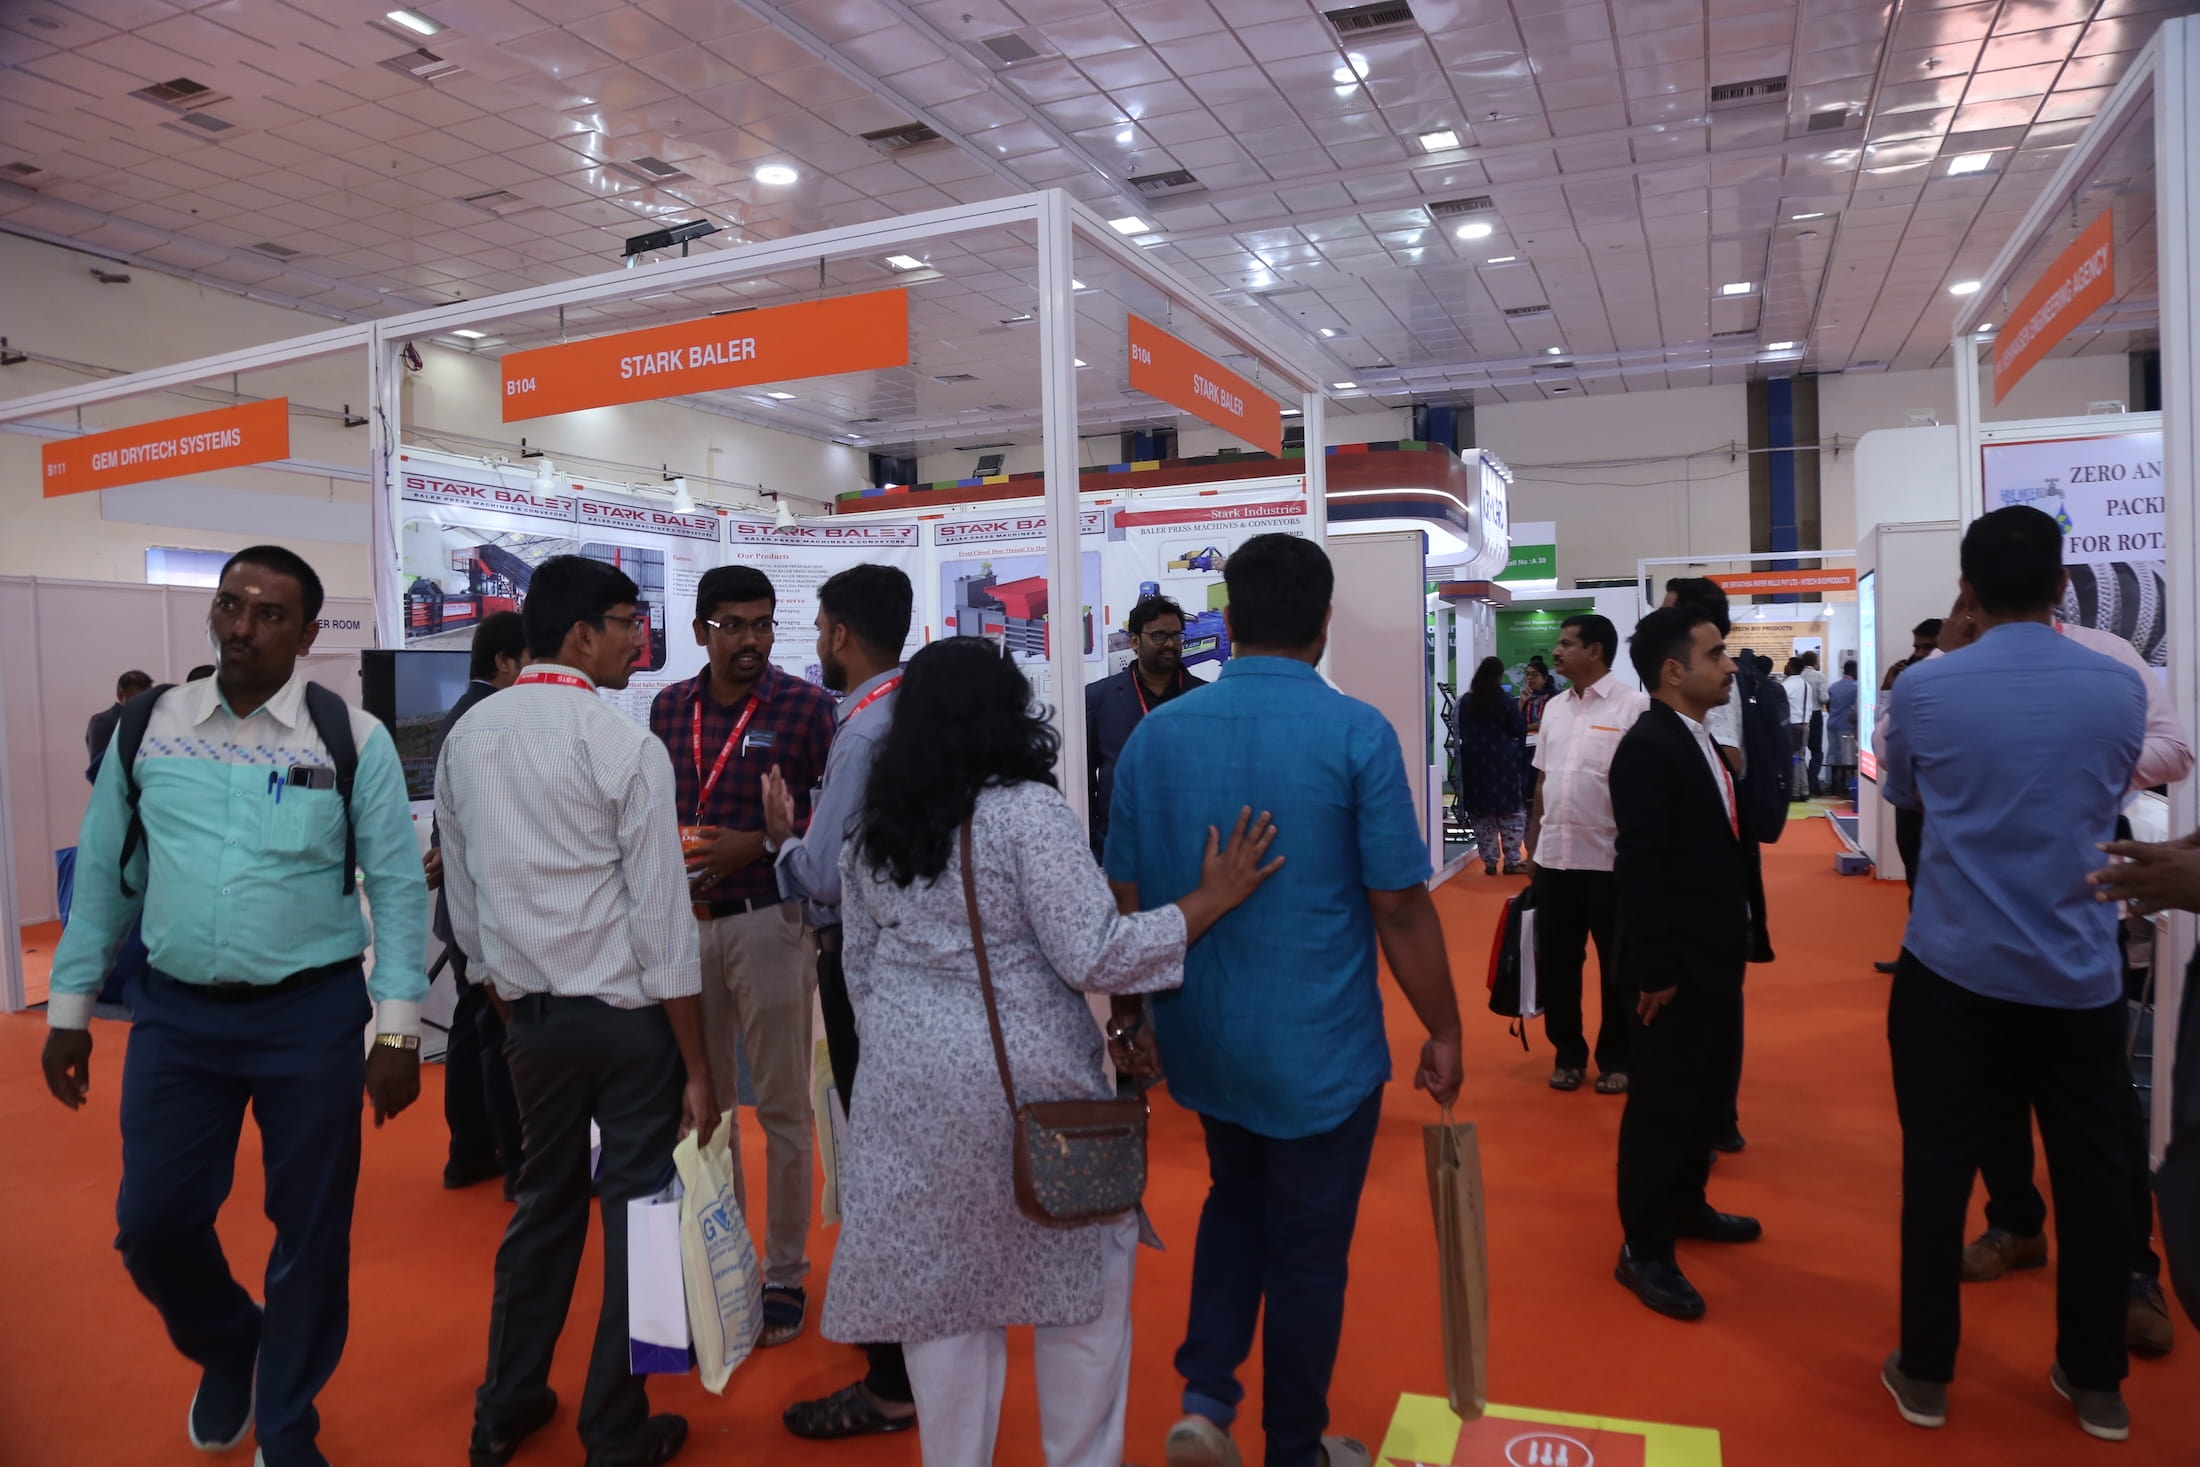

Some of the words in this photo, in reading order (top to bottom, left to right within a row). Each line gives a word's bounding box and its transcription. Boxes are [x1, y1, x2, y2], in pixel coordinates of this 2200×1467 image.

[2073, 243, 2109, 297] AGENCY
[620, 348, 684, 378] STARK
[690, 338, 756, 368] BALER
[1132, 344, 1152, 364] B104
[507, 377, 536, 395] B104
[1194, 374, 1220, 404] STARK
[1220, 390, 1244, 418] BALER
[92, 452, 118, 471] GEM
[121, 442, 176, 466] DRYTECH
[180, 428, 241, 455] SYSTEMS
[48, 462, 66, 476] B111
[2070, 464, 2126, 484] ZERO
[2132, 461, 2162, 480] AN
[407, 478, 486, 498] STARK
[495, 490, 572, 510] BALER
[473, 501, 514, 510] MACHINES
[524, 508, 567, 518] CONVEYORS
[582, 503, 646, 521] STARK
[653, 514, 716, 531] BALER
[1211, 508, 1240, 519] Stark
[1244, 505, 1301, 516] Industries
[636, 524, 670, 532] MACHINES
[678, 529, 712, 537] CONVEYORS
[738, 524, 816, 537] STARK
[825, 528, 912, 537] BALER
[941, 522, 1008, 536] STARK
[1194, 522, 1239, 532] MACHINES
[1248, 518, 1300, 527] CONVEYORS
[2070, 536, 2110, 553] FOR
[2118, 532, 2166, 551] ROT
[333, 620, 360, 630] ROOM
